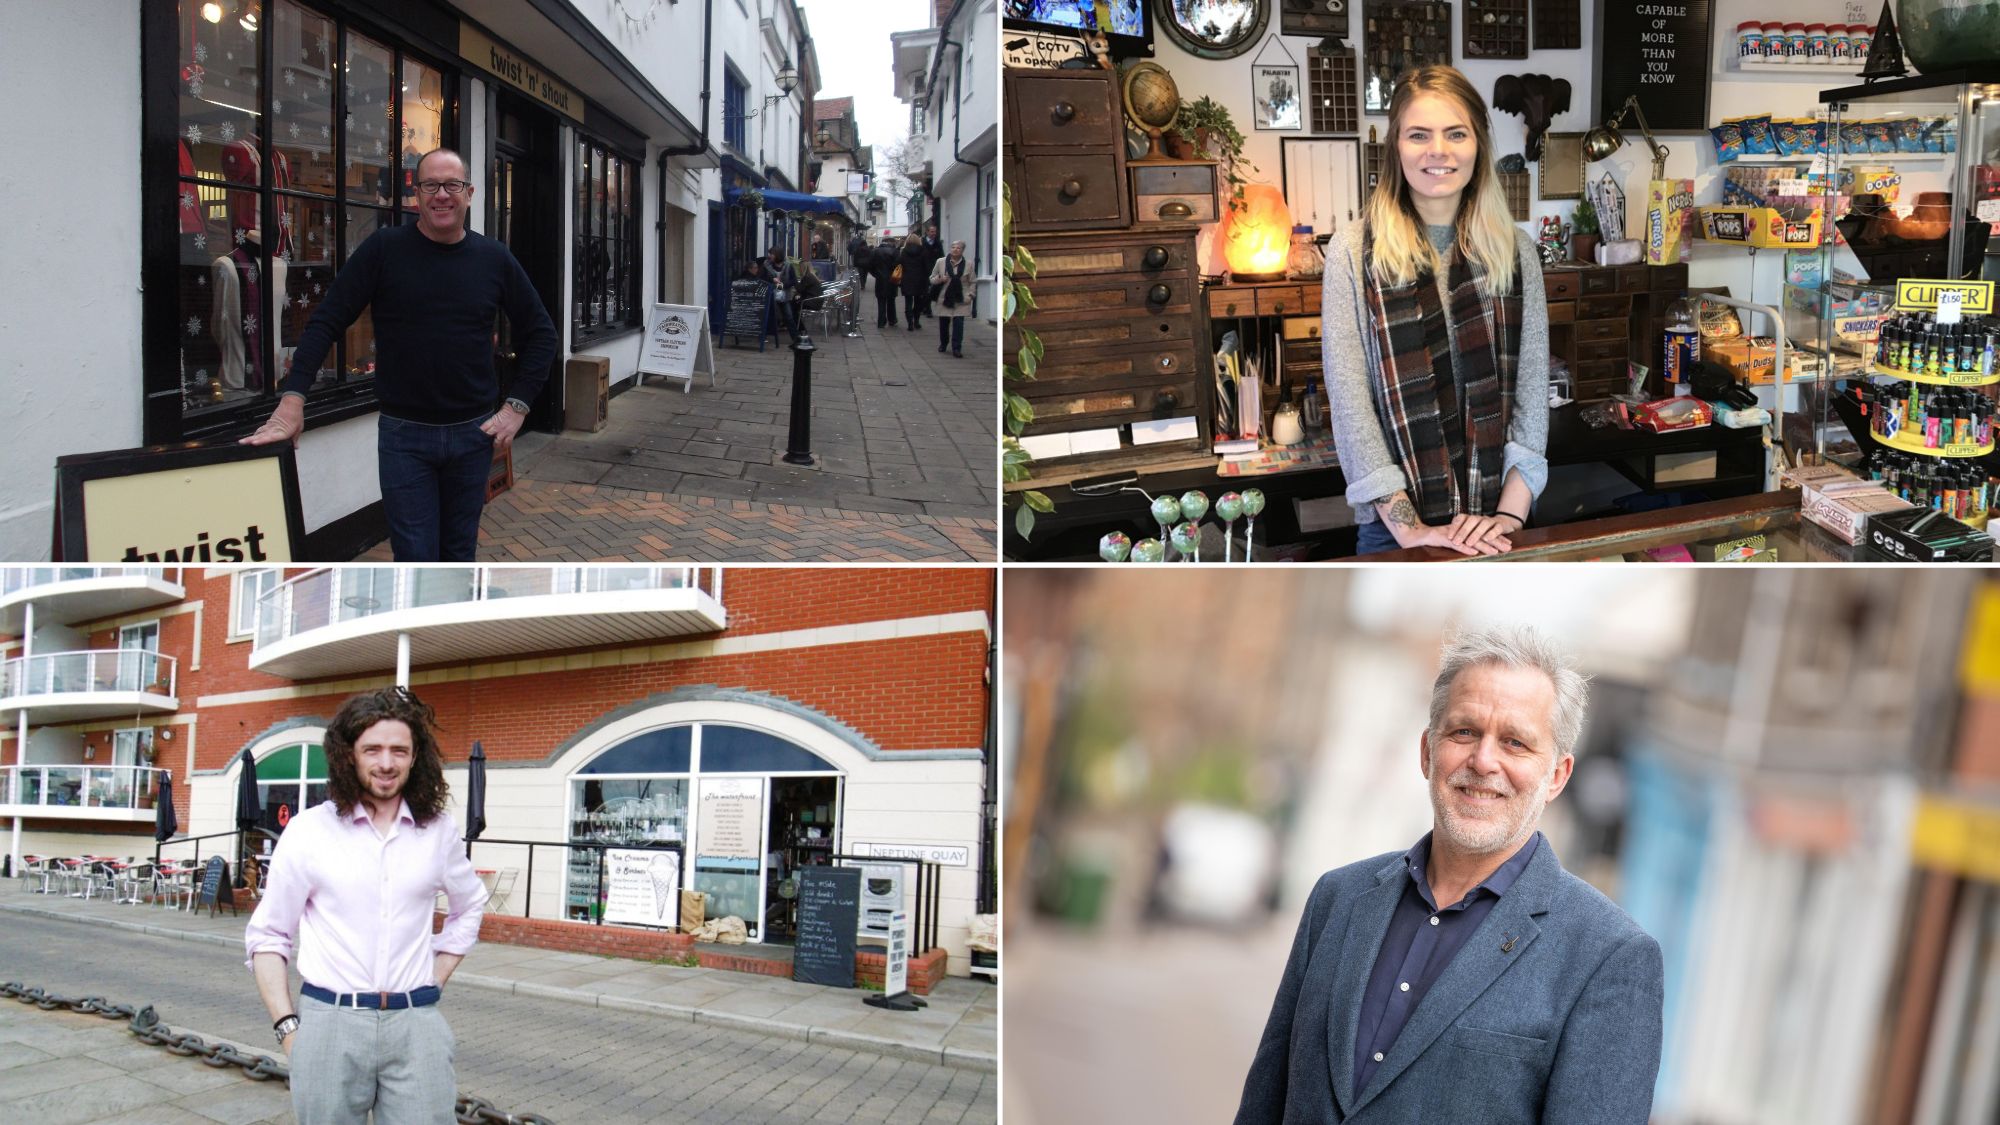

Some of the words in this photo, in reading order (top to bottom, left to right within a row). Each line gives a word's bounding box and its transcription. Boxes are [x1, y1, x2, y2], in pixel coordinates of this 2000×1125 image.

[1636, 4, 1687, 17] CAPABLE
[1651, 19, 1667, 29] OF
[1641, 32, 1675, 43] MORE
[1037, 41, 1070, 53] CCTV
[1009, 53, 1020, 63] in
[1641, 48, 1675, 59] THAN
[1647, 62, 1668, 72] YOU
[489, 45, 522, 84] twist
[542, 80, 569, 111] shout
[1640, 73, 1675, 84] KNOW
[1866, 175, 1900, 191] DOTS
[1717, 221, 1741, 234] POPS
[1787, 230, 1808, 242] POPS
[1793, 262, 1822, 273] POPS
[1843, 319, 1878, 333] SNICKERS
[1753, 356, 1771, 367] Duds
[1817, 502, 1853, 527] KUSH
[1873, 530, 1906, 558] OCB
[873, 848, 926, 860] NEPTUNE
[931, 850, 965, 862] QUAY
